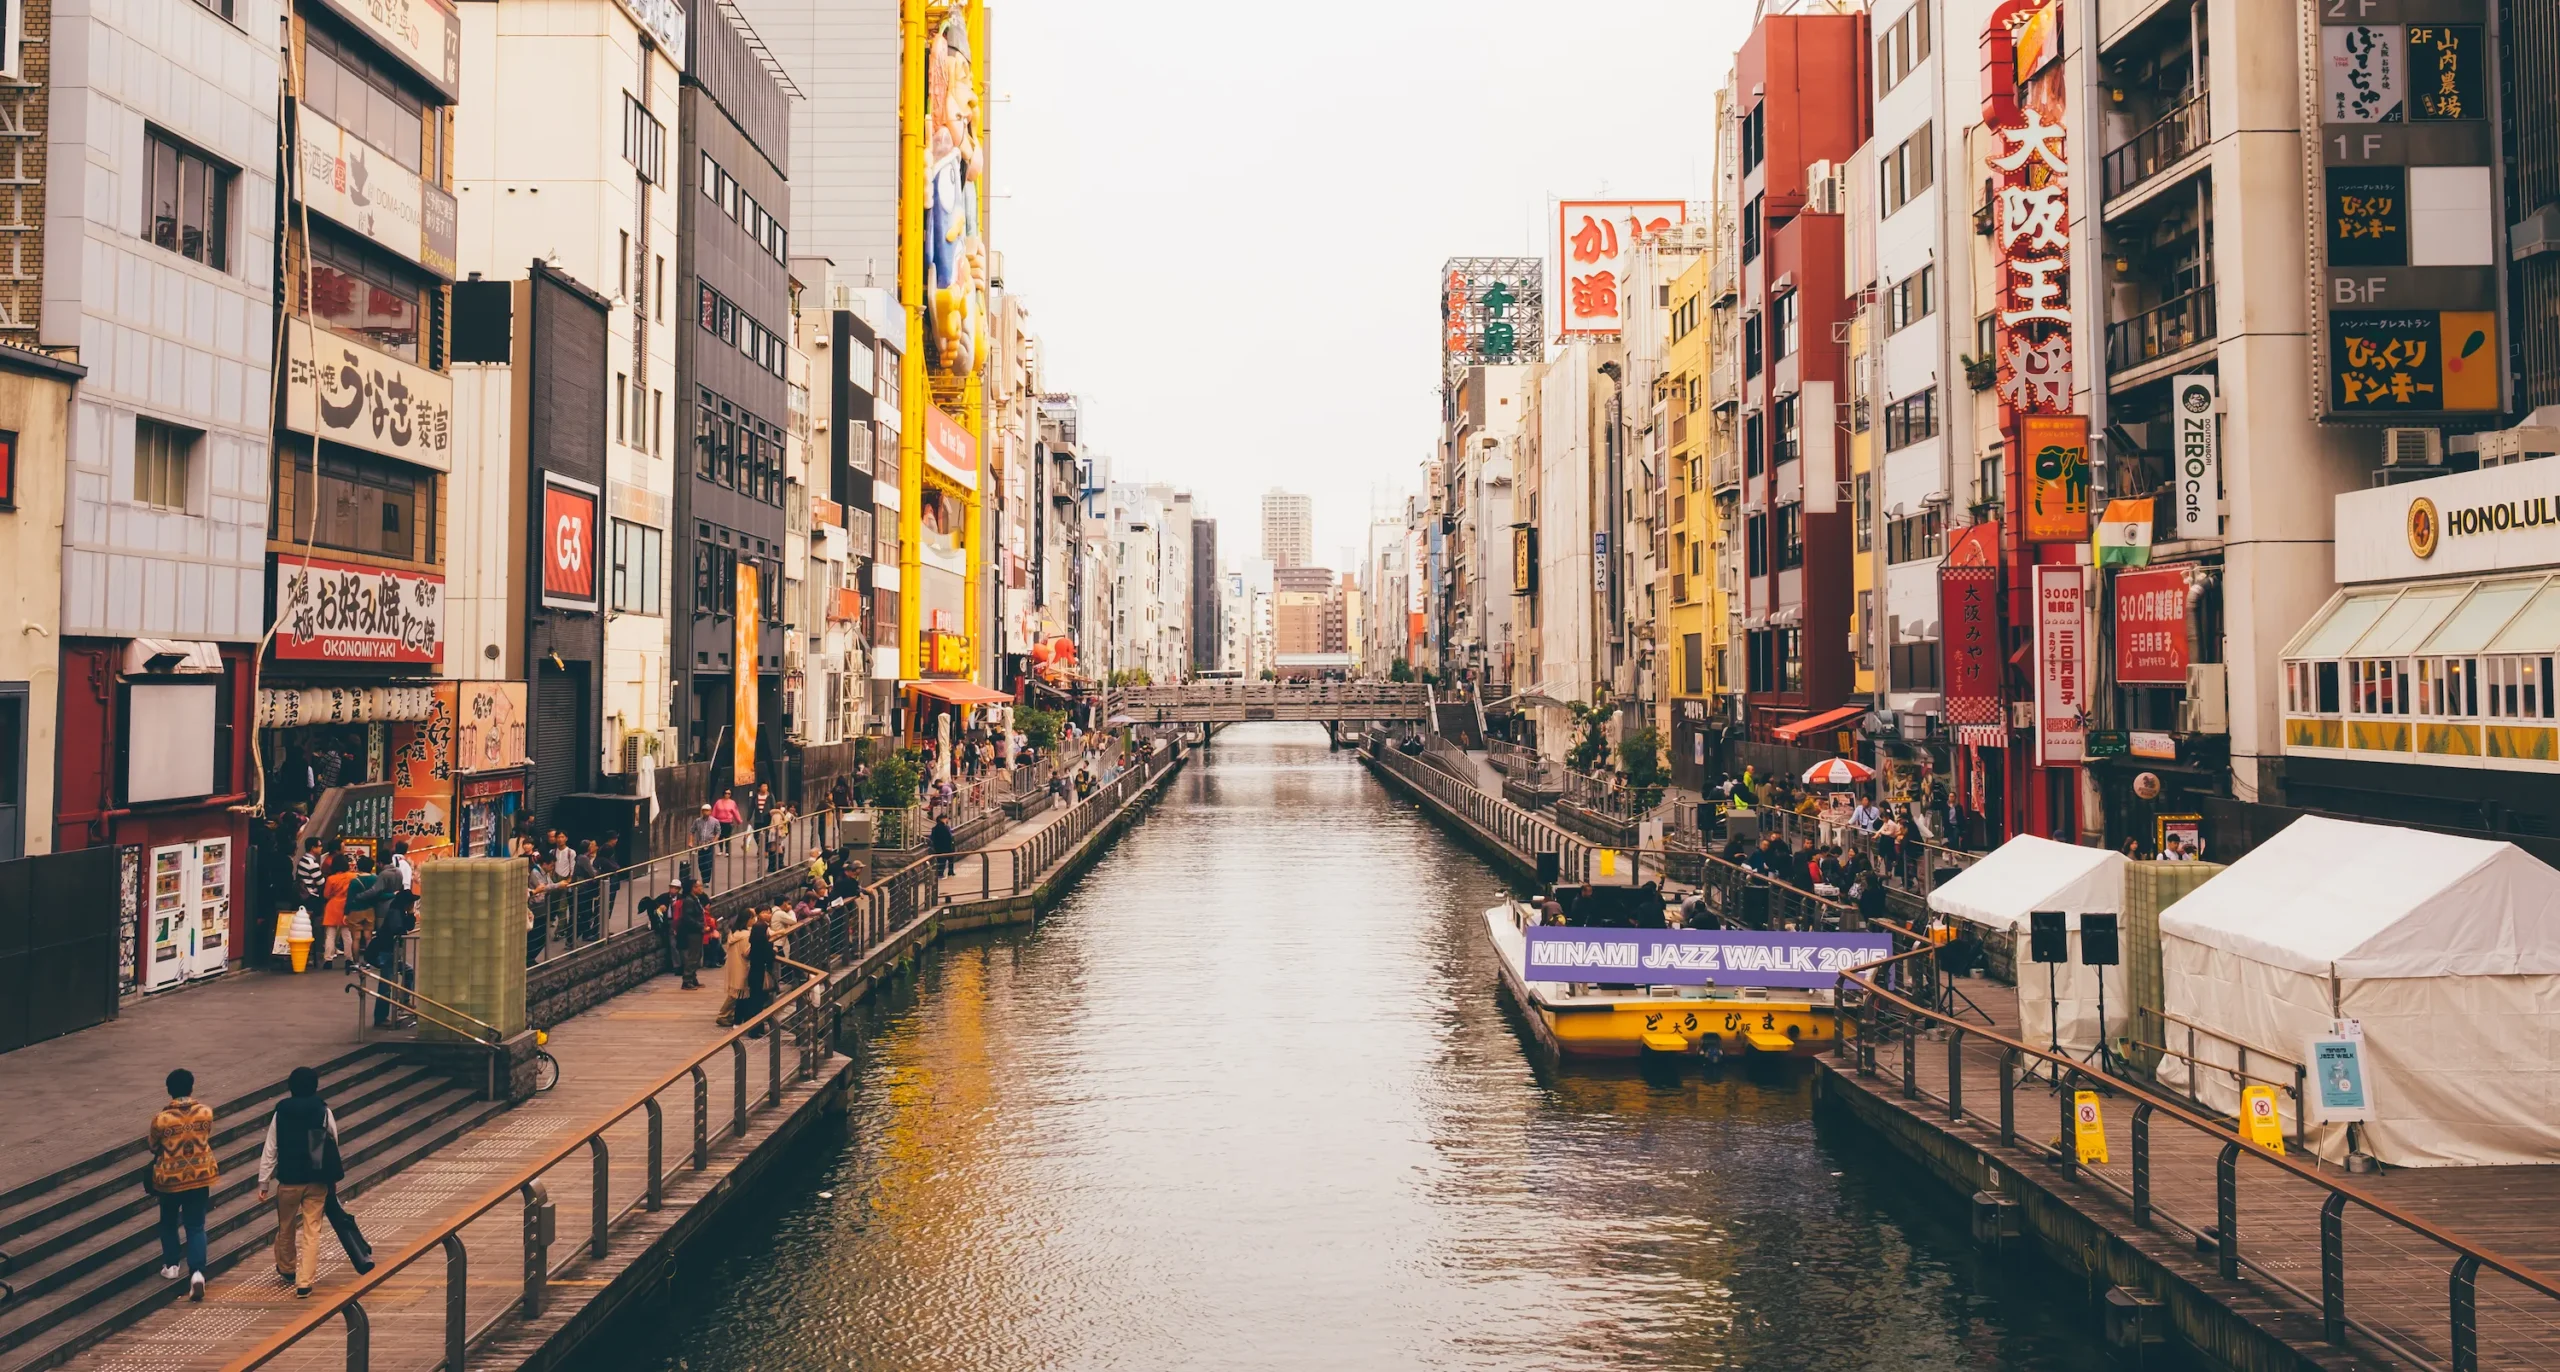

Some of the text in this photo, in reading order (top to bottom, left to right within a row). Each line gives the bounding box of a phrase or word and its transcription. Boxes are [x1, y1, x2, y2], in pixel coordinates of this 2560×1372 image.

[2410, 28, 2433, 44] 2F
[2437, 28, 2462, 119] 山内農場
[2388, 112, 2401, 121] 2F
[2341, 196, 2392, 217] びっくり
[2338, 218, 2396, 239] ドンキー
[1997, 108, 2072, 410] 大阪王将
[1572, 270, 1618, 318] 道
[2335, 277, 2387, 303] B1F
[1481, 281, 1516, 354] 千房
[2340, 319, 2432, 329] ハンバーグレストラン
[2344, 336, 2427, 371] びっくり
[320, 349, 414, 447] うなぎ
[2341, 371, 2434, 404] ドンキー
[2184, 418, 2205, 478] ZERO
[2204, 418, 2212, 466] DOUTONBORI
[556, 514, 581, 572] G3
[316, 573, 401, 637] お好み焼
[2044, 588, 2079, 600] 300円
[2048, 601, 2074, 613] 雑貨店
[2120, 588, 2184, 622] 300円雑貨店
[291, 606, 315, 646] 大阪
[401, 606, 436, 657] たこ焼
[1963, 584, 1984, 681] 大阪みやげ
[2130, 632, 2172, 652] 三日月百子
[322, 639, 396, 657] OKONOMIYAKI
[2059, 630, 2075, 705] 三日月百子
[427, 700, 452, 781] お好み焼
[1531, 941, 1639, 968] MINAMI
[1642, 943, 1720, 970] JAZZ
[1722, 945, 1818, 972] WALK
